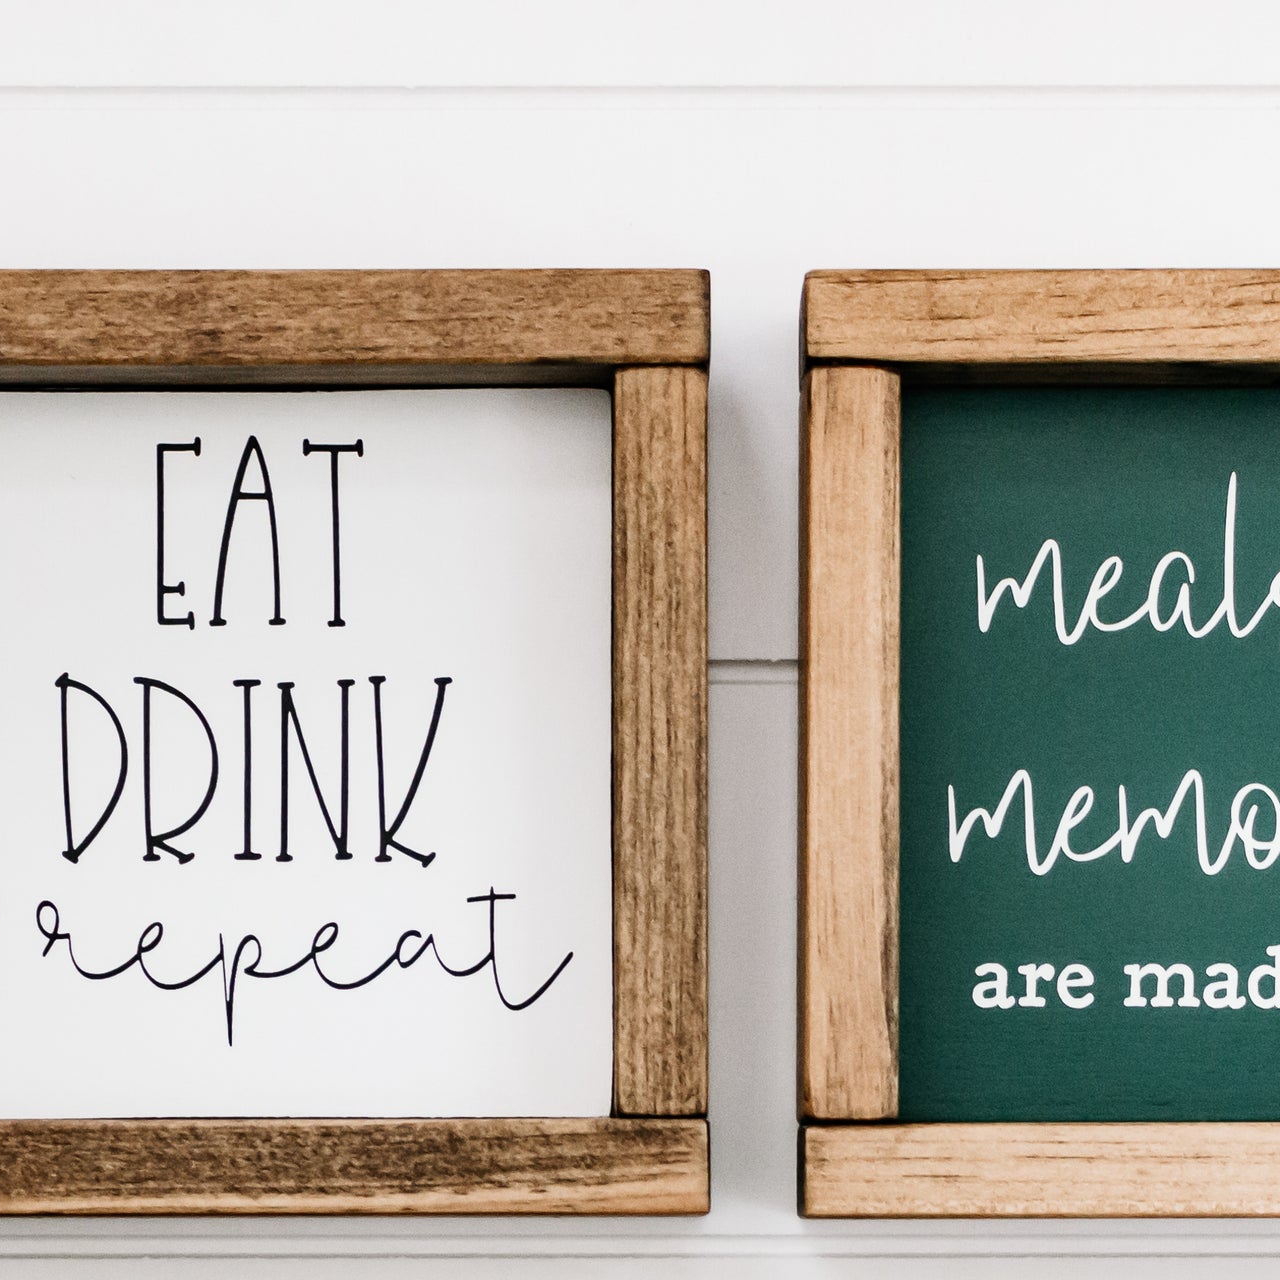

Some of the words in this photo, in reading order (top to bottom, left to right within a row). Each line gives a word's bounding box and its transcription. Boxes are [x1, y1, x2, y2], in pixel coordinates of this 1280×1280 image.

[156, 435, 364, 631] EAT
[54, 672, 453, 869] DRINK
[36, 886, 574, 1047] repeat
[972, 962, 1095, 1010] are
